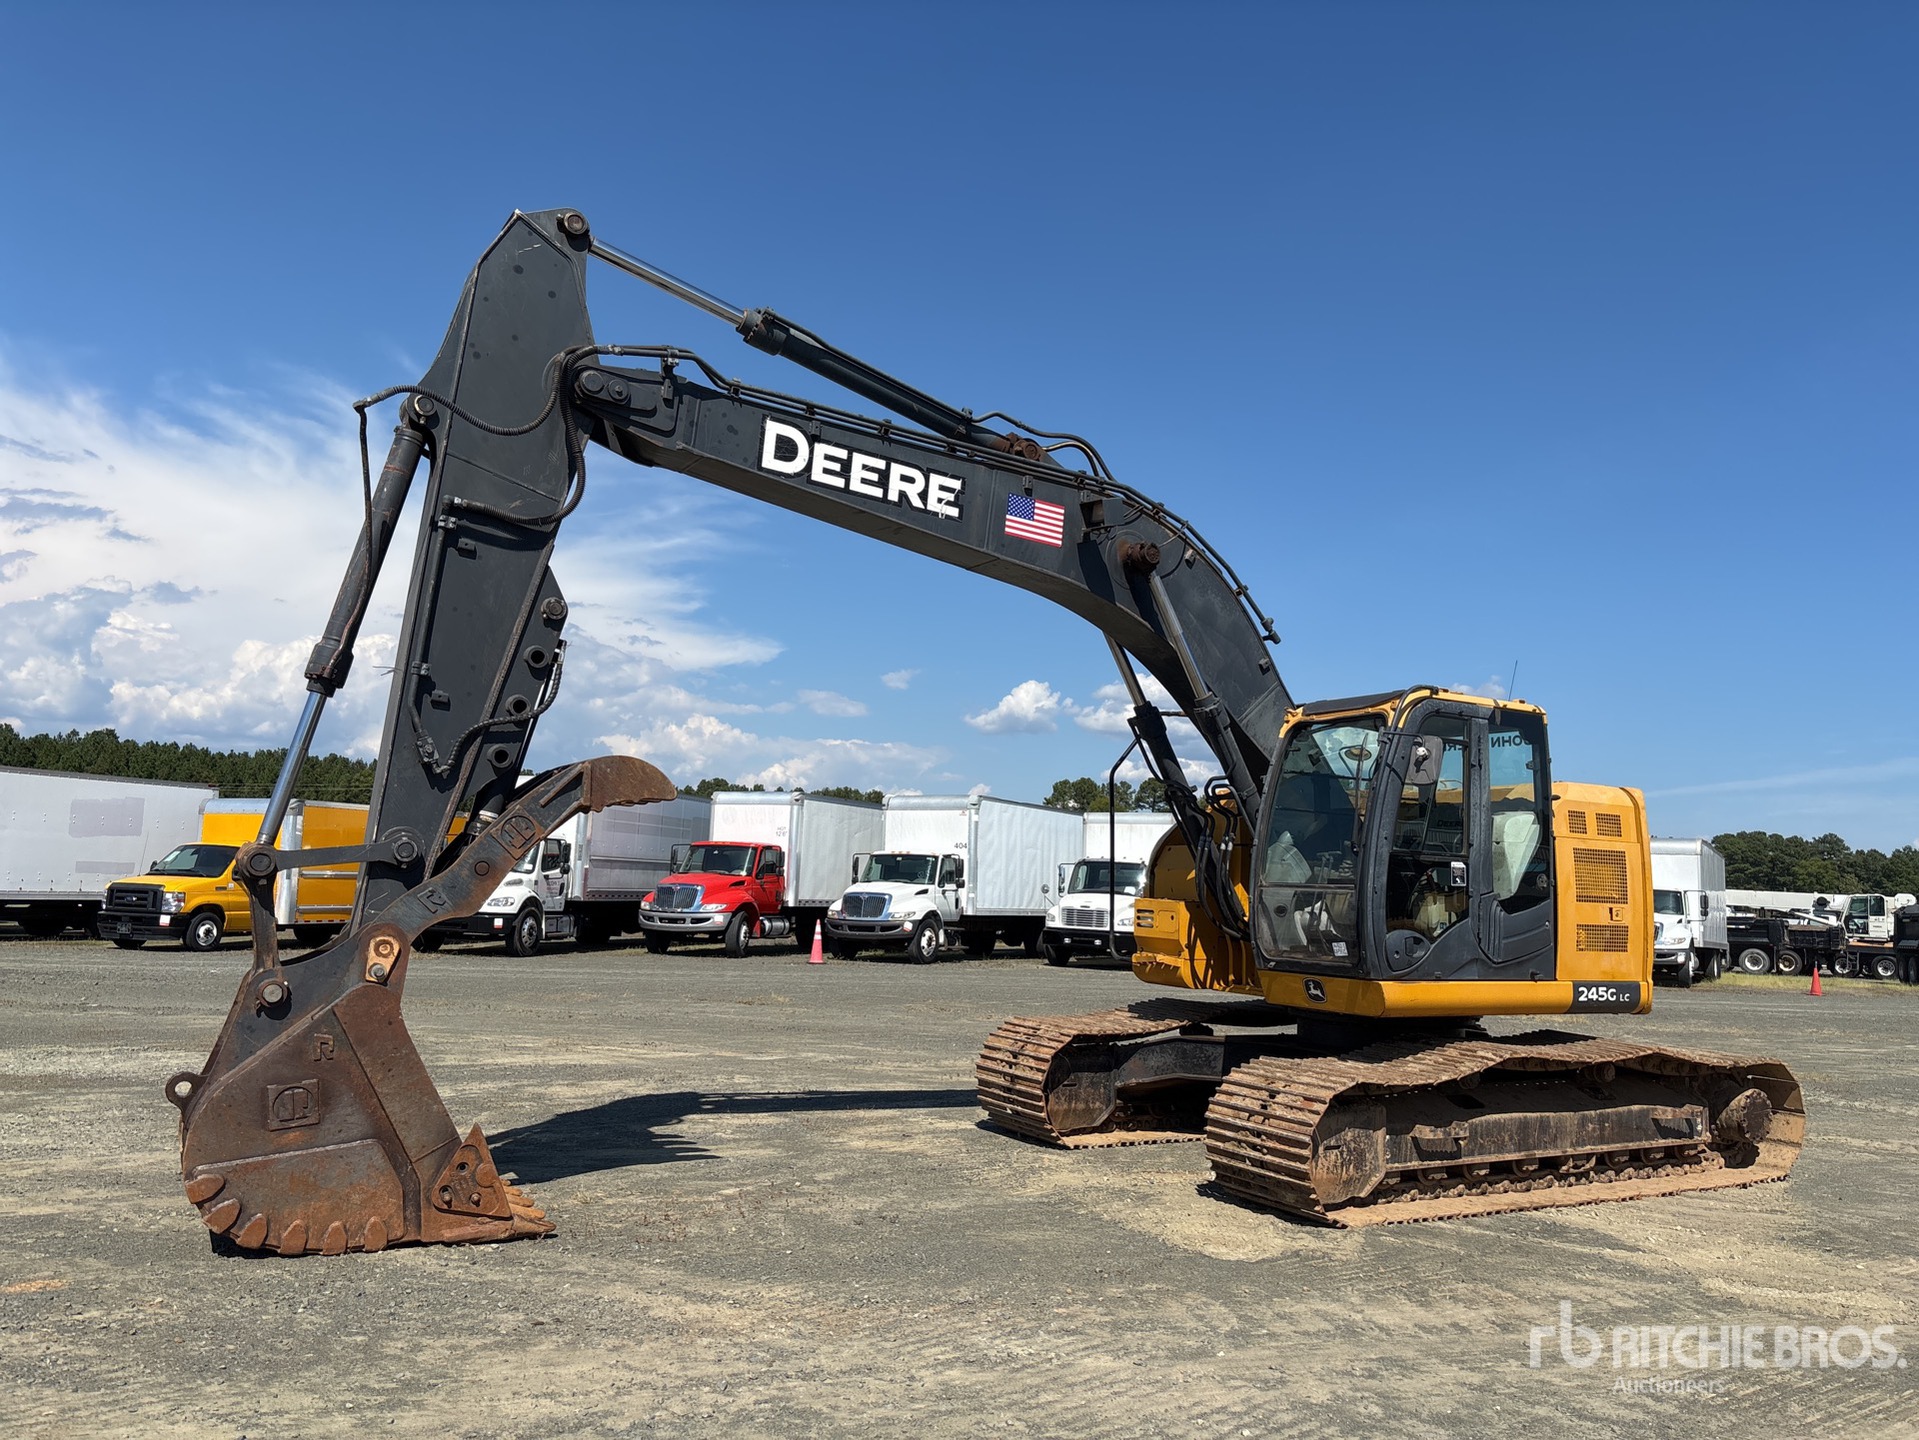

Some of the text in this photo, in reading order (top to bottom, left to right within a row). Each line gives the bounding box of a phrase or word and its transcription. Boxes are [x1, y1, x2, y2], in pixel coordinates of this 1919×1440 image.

[761, 418, 963, 520] DEERE
[1578, 986, 1630, 1002] 245G LC
